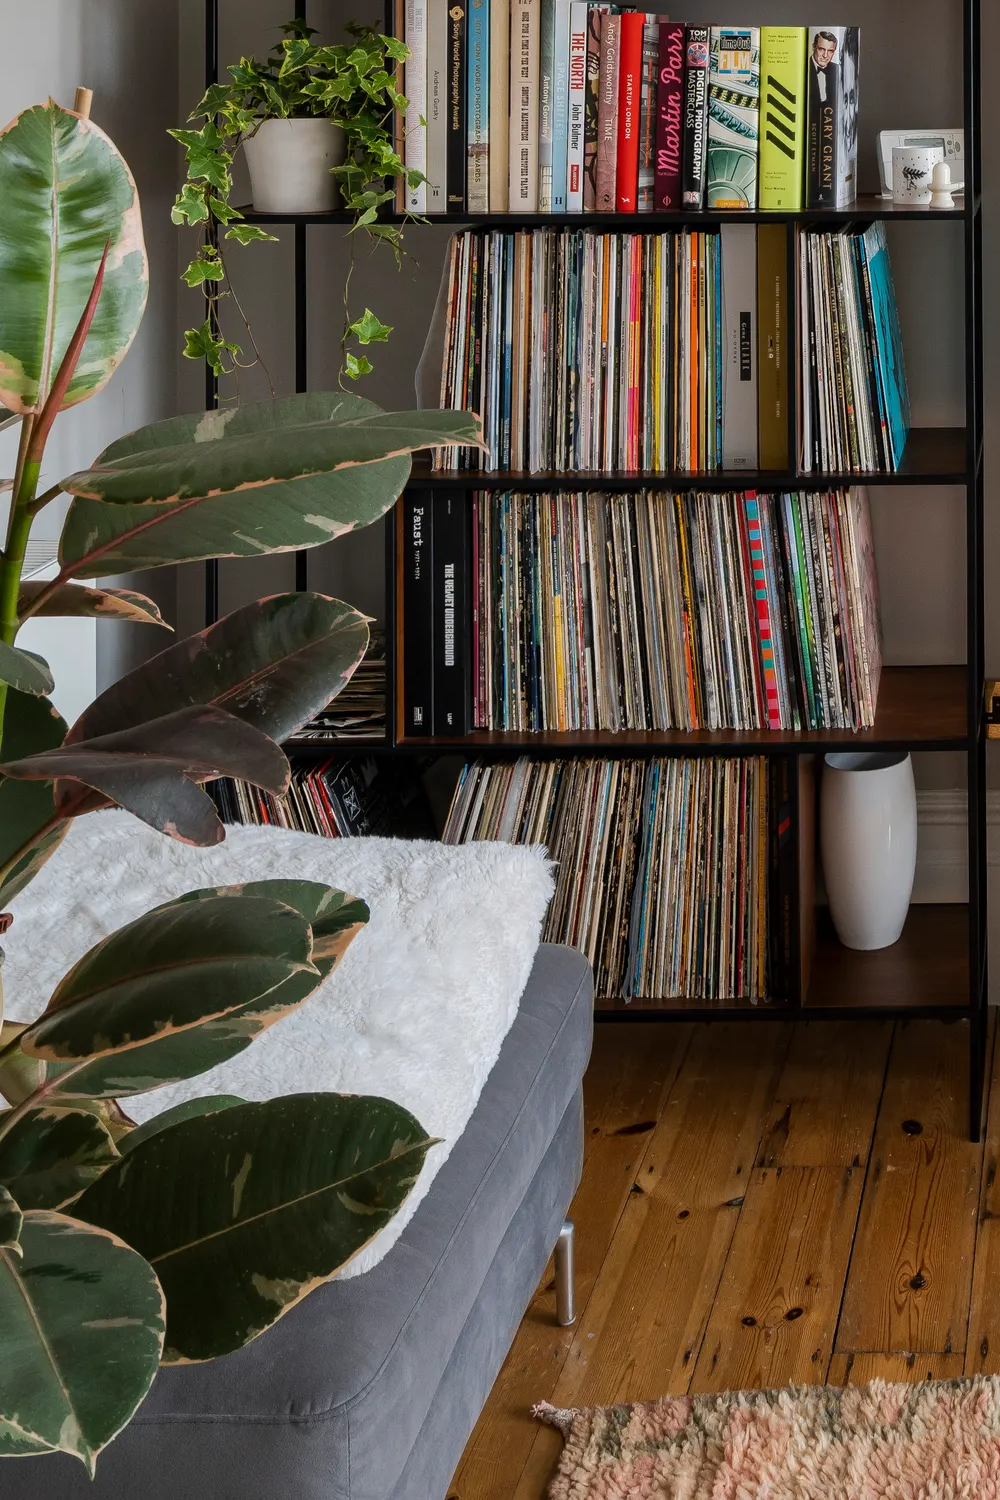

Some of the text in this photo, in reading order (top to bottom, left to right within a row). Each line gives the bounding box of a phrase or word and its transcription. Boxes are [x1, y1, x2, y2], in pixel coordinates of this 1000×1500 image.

[452, 23, 460, 37] Sony
[521, 11, 529, 22] ONCE
[521, 23, 529, 34] UPON
[521, 40, 529, 50] TIME
[521, 57, 529, 65] THE
[571, 32, 585, 90] THE NORTH
[660, 28, 683, 84] Parr
[720, 51, 751, 69] FILM
[521, 66, 529, 78] WEST
[604, 22, 615, 105] Andy Goldsworthy
[451, 62, 460, 105] Photography
[521, 86, 529, 107] SHOOTING
[686, 69, 695, 128] MASTERCLASS
[432, 98, 440, 121] Gursky
[541, 75, 550, 139] Antony Gormley
[555, 61, 565, 141] SPACE SHIFTERS
[521, 112, 529, 141] MASTERPIECE
[570, 103, 582, 150] John Bulmer
[604, 118, 613, 141] TIME
[657, 92, 681, 173] Martin
[692, 70, 705, 180] DIGITAL PHOTOGRAPHY
[520, 148, 529, 176] CHRISTOPHER
[822, 106, 833, 190] CARY GRANT
[742, 341, 750, 370] CLARK
[413, 507, 423, 546] Faust
[444, 563, 454, 666] THE VELVET UNDERGROUND
